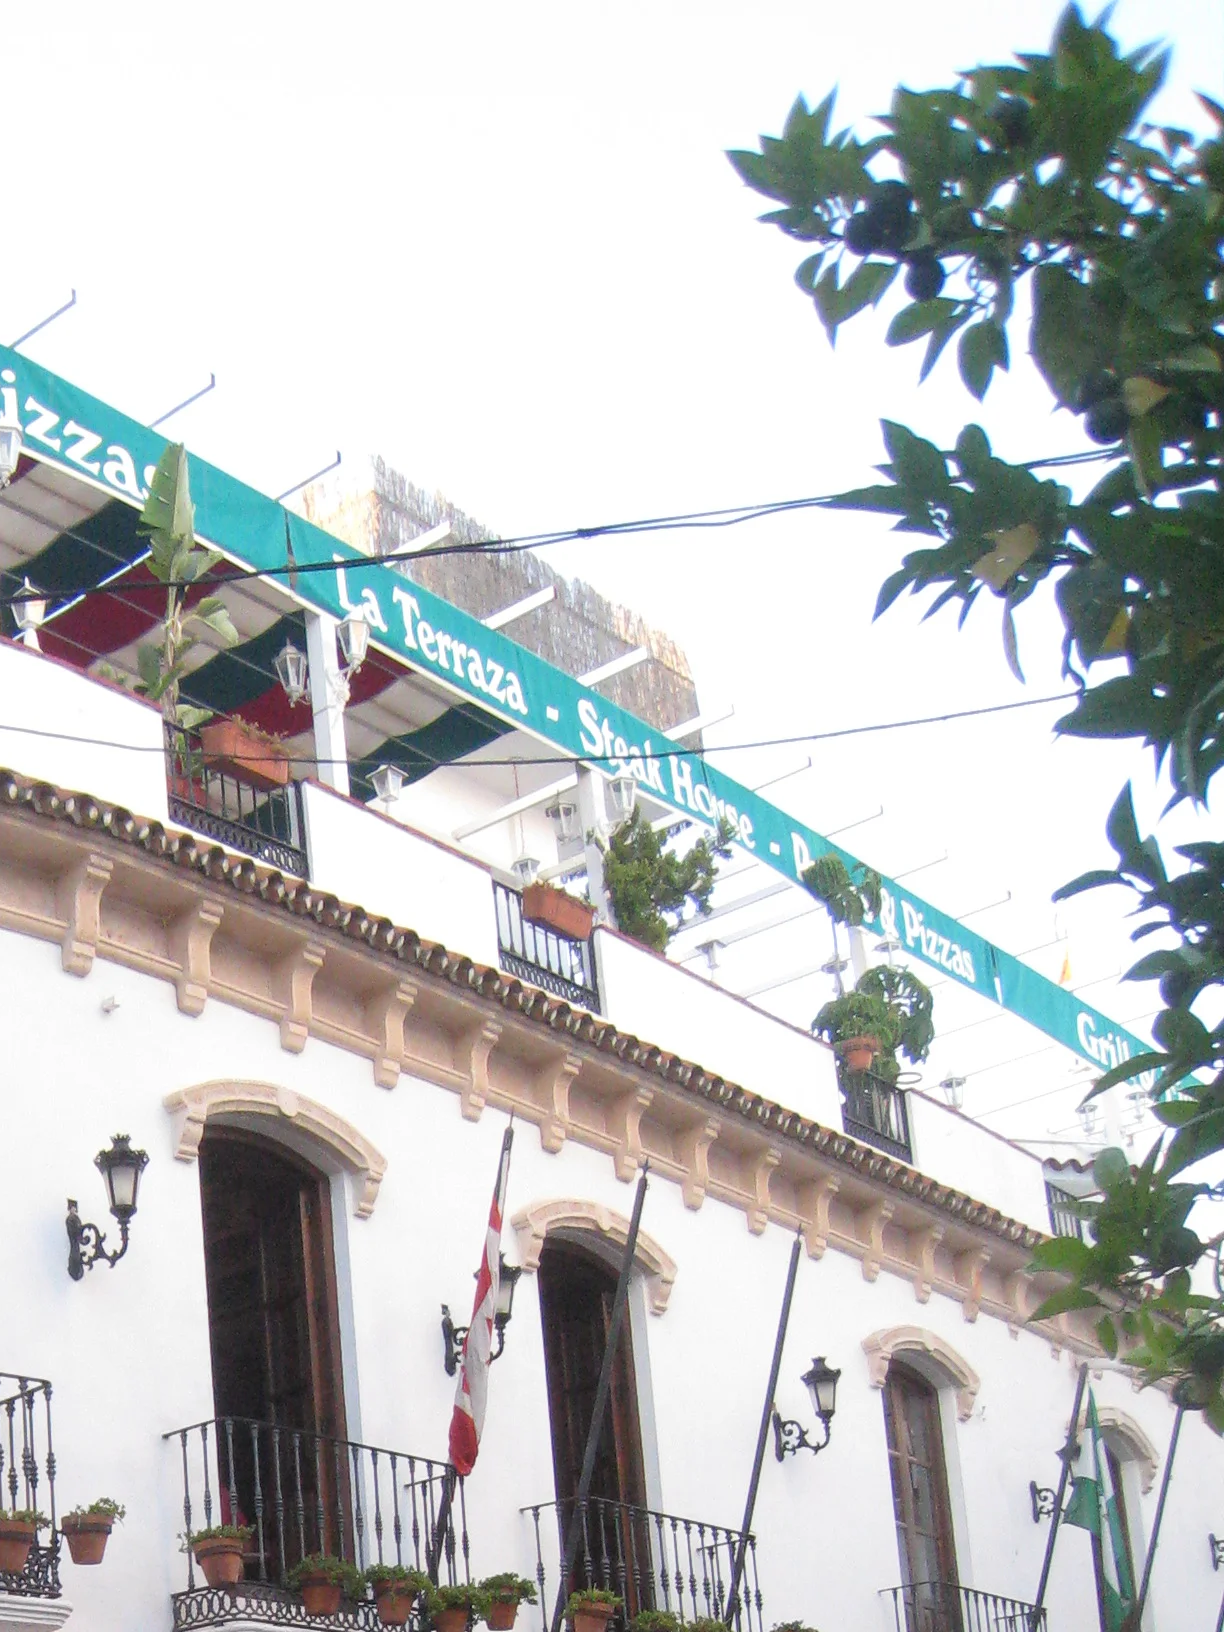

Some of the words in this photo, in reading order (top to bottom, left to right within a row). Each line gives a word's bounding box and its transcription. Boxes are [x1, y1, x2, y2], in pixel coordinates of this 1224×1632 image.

[333, 552, 387, 633] La
[392, 586, 528, 715] Terraza
[577, 697, 667, 796] Steak
[668, 754, 755, 849] House
[900, 899, 976, 983] Pizzas
